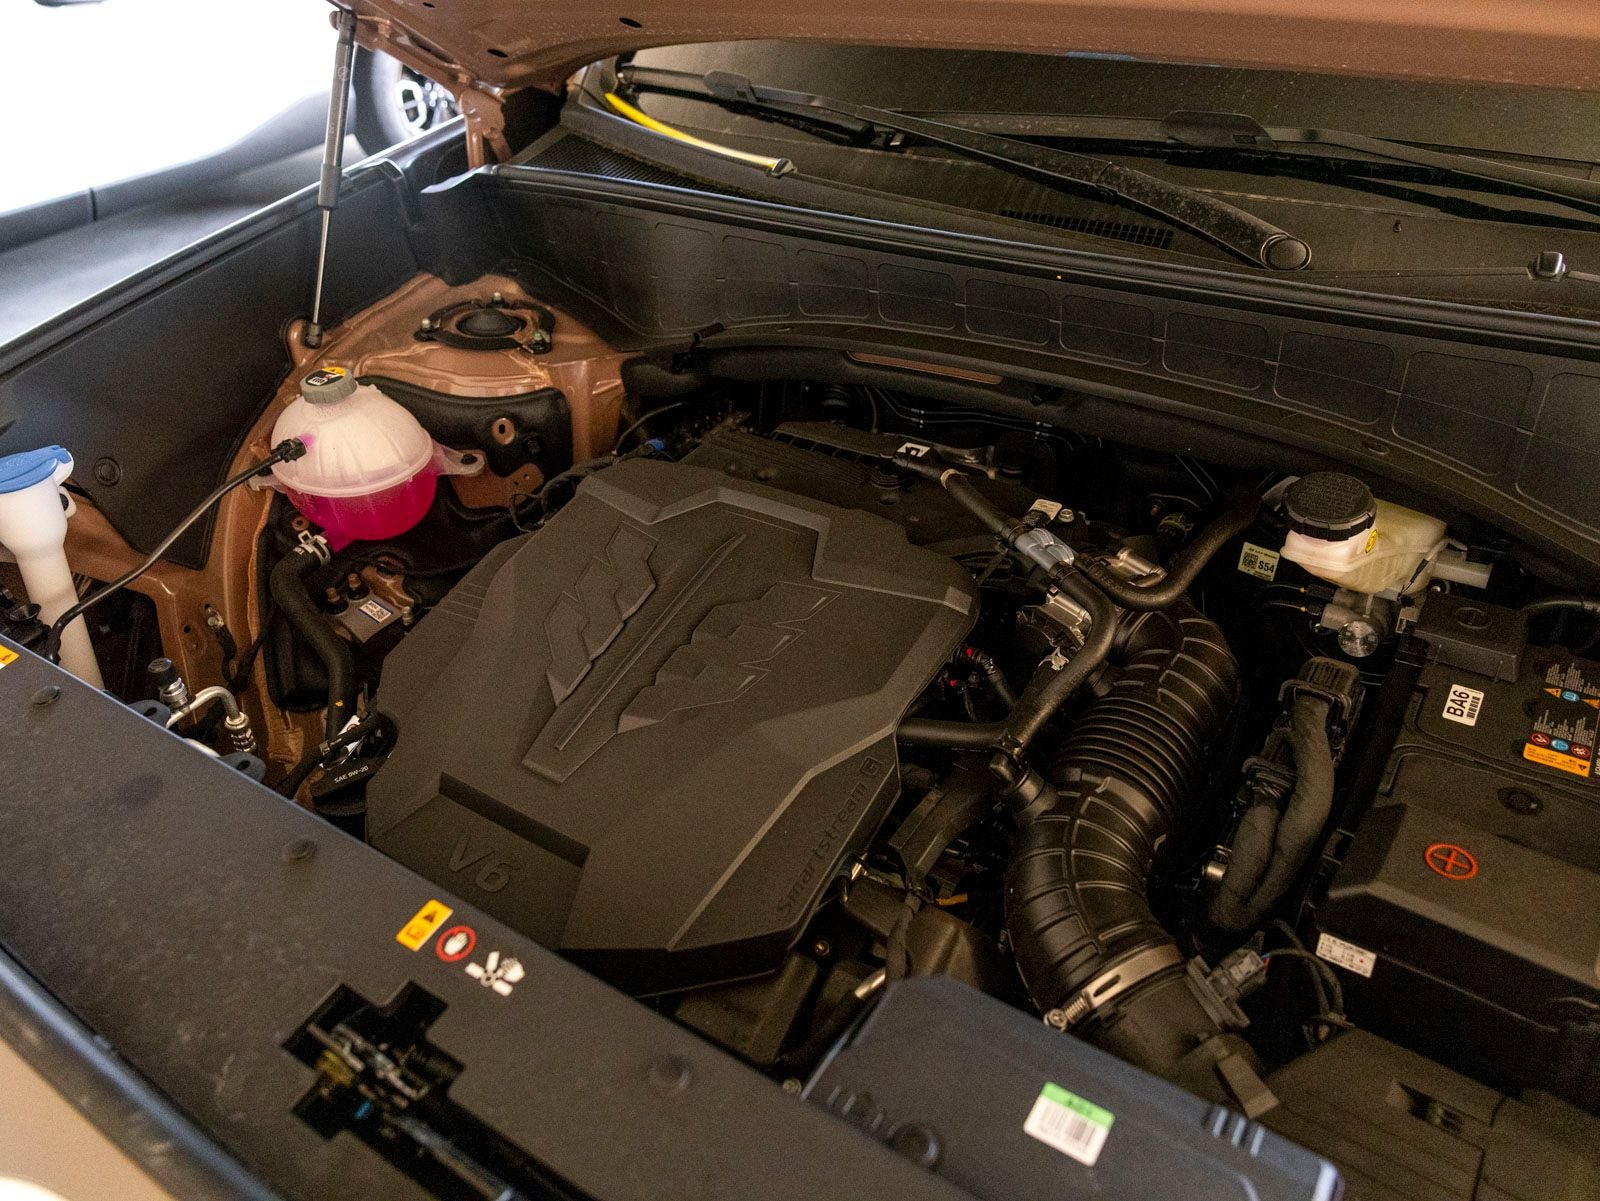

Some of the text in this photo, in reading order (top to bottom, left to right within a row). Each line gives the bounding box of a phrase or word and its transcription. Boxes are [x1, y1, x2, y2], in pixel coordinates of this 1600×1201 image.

[1257, 560, 1275, 573] S54
[1446, 689, 1470, 718] BA6
[333, 773, 348, 783] SAE
[449, 834, 520, 892] V6
